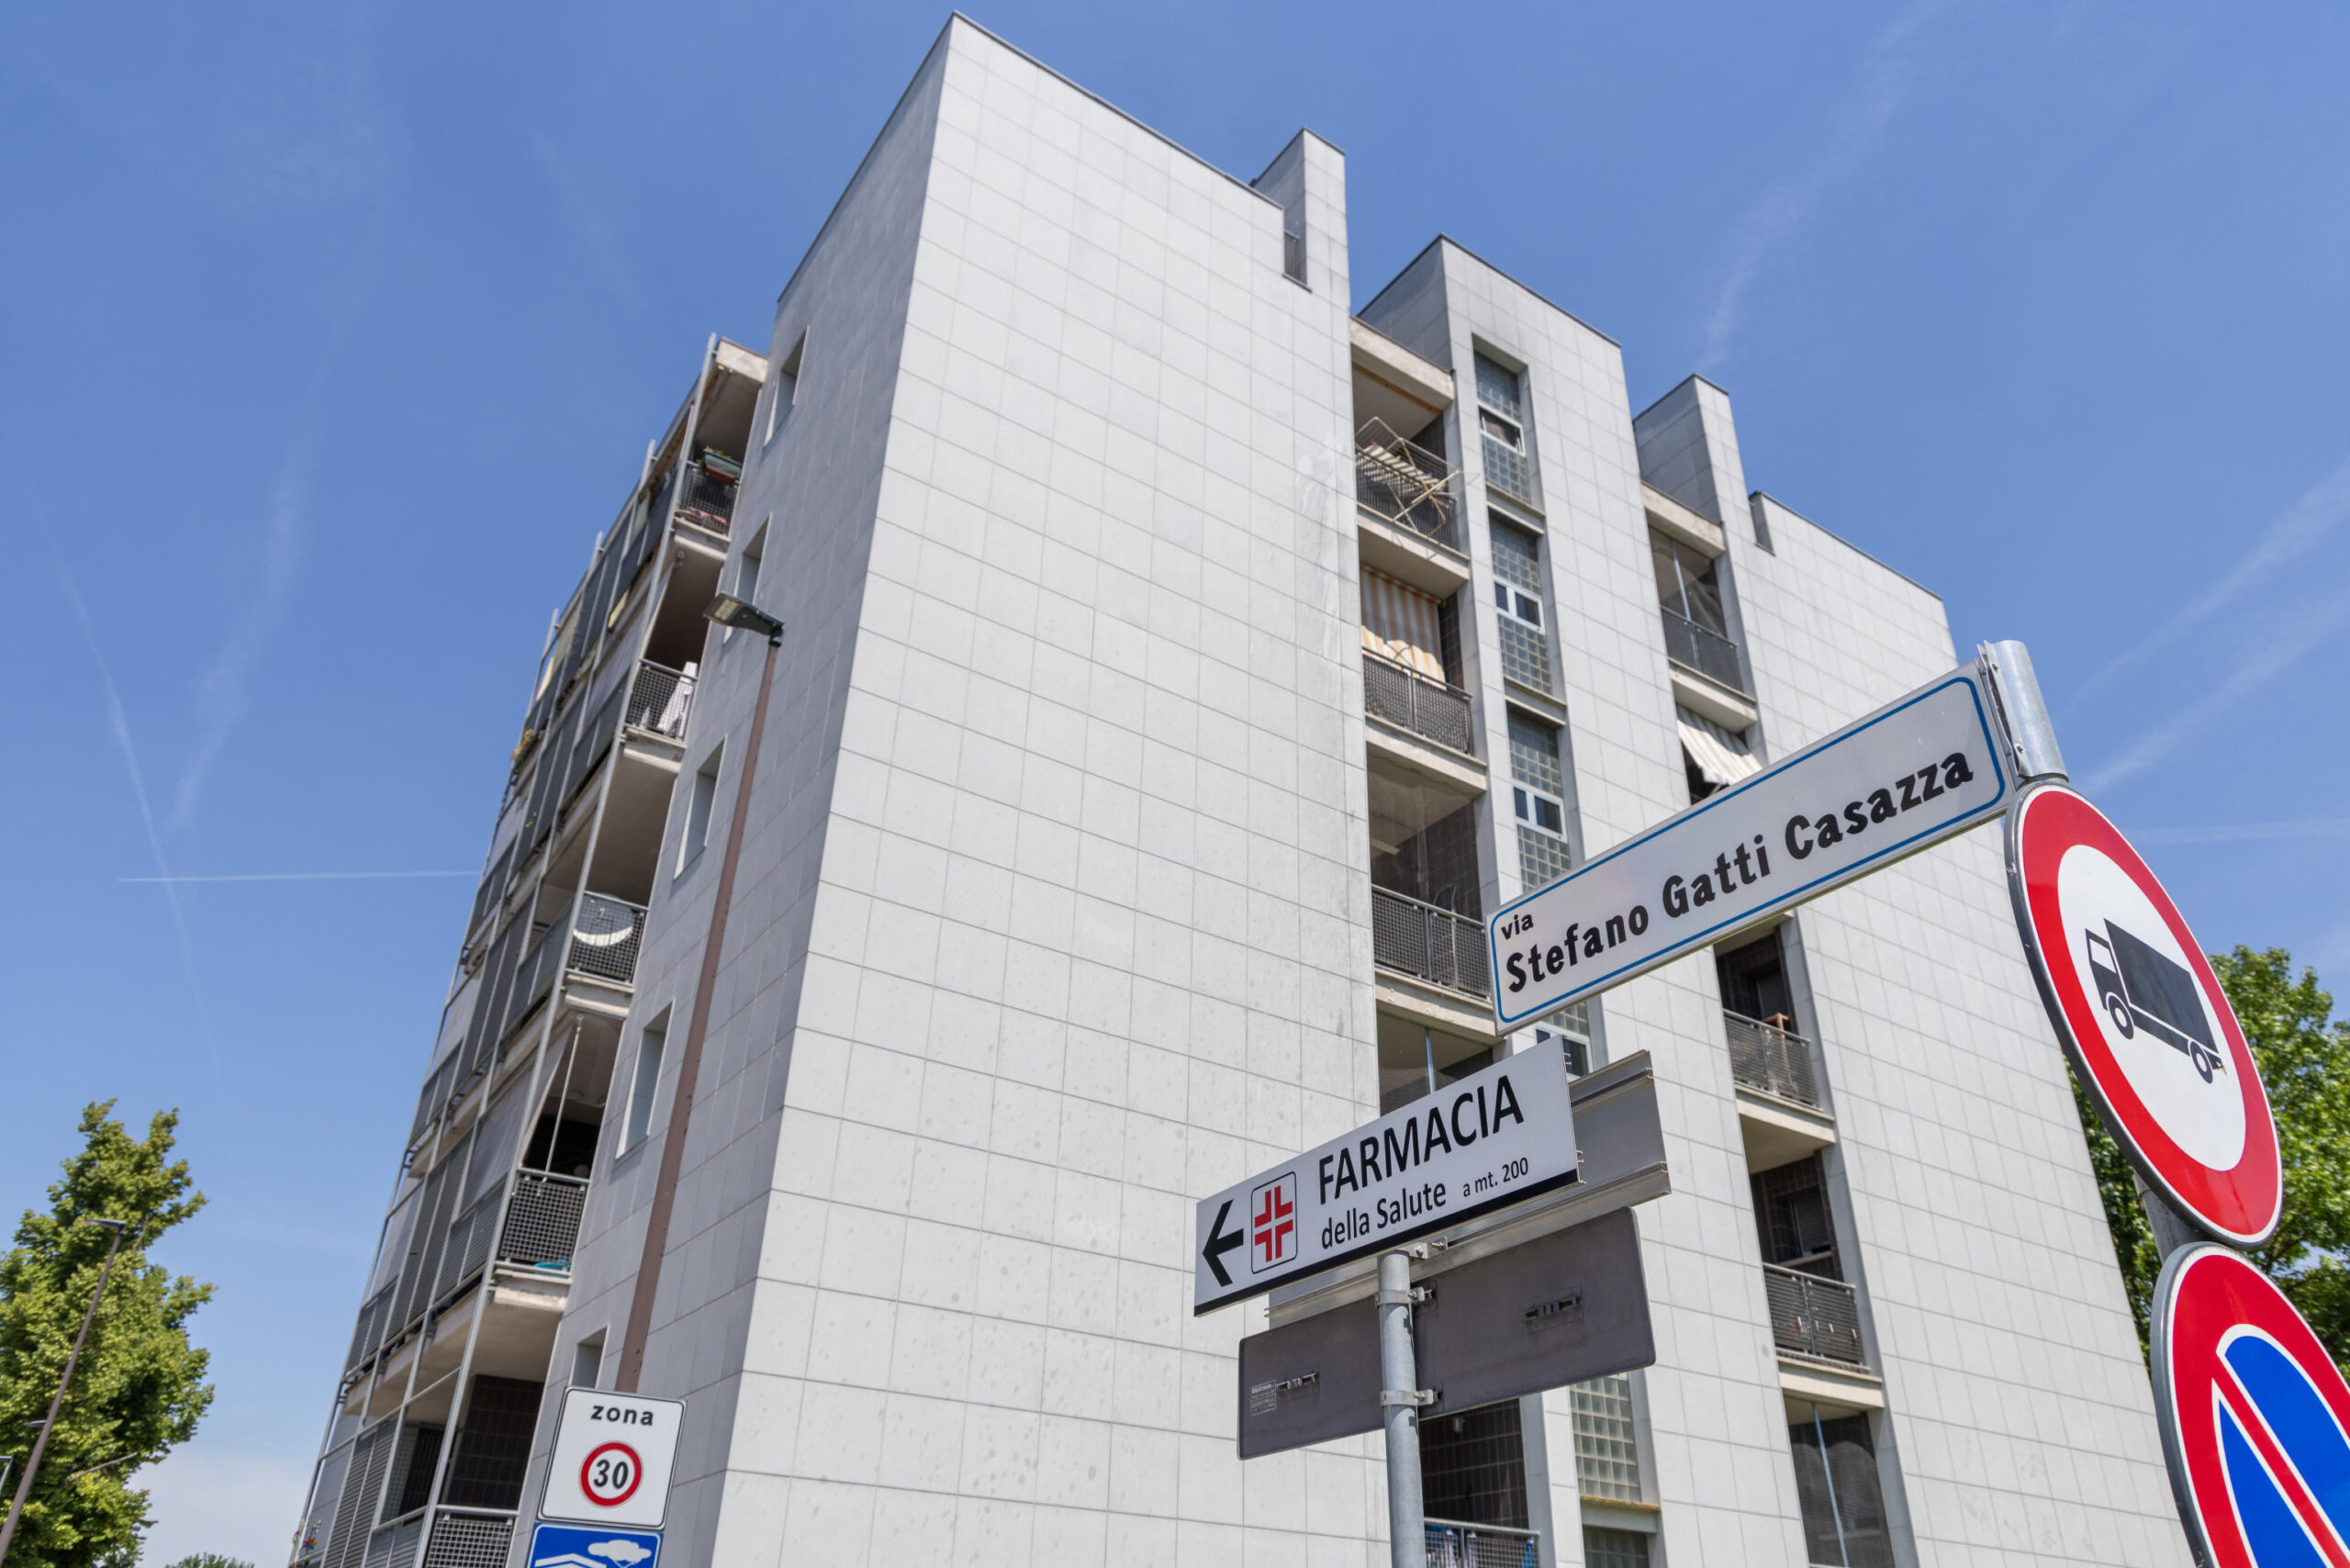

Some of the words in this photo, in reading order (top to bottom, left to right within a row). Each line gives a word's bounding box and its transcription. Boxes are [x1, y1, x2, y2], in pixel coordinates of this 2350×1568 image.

[1505, 904, 1650, 993] Stefano
[1662, 834, 1772, 919] Gatti
[1785, 751, 1974, 860] Casazza
[1500, 911, 1534, 940] via
[1318, 1074, 1525, 1205] FARMACIA
[1321, 1207, 1371, 1250] della
[1376, 1182, 1448, 1230] Salute
[1462, 1182, 1472, 1198] a
[1474, 1170, 1499, 1193] mt.
[1501, 1156, 1529, 1184] 200
[590, 1405, 654, 1427] zona
[593, 1459, 629, 1490] 30
